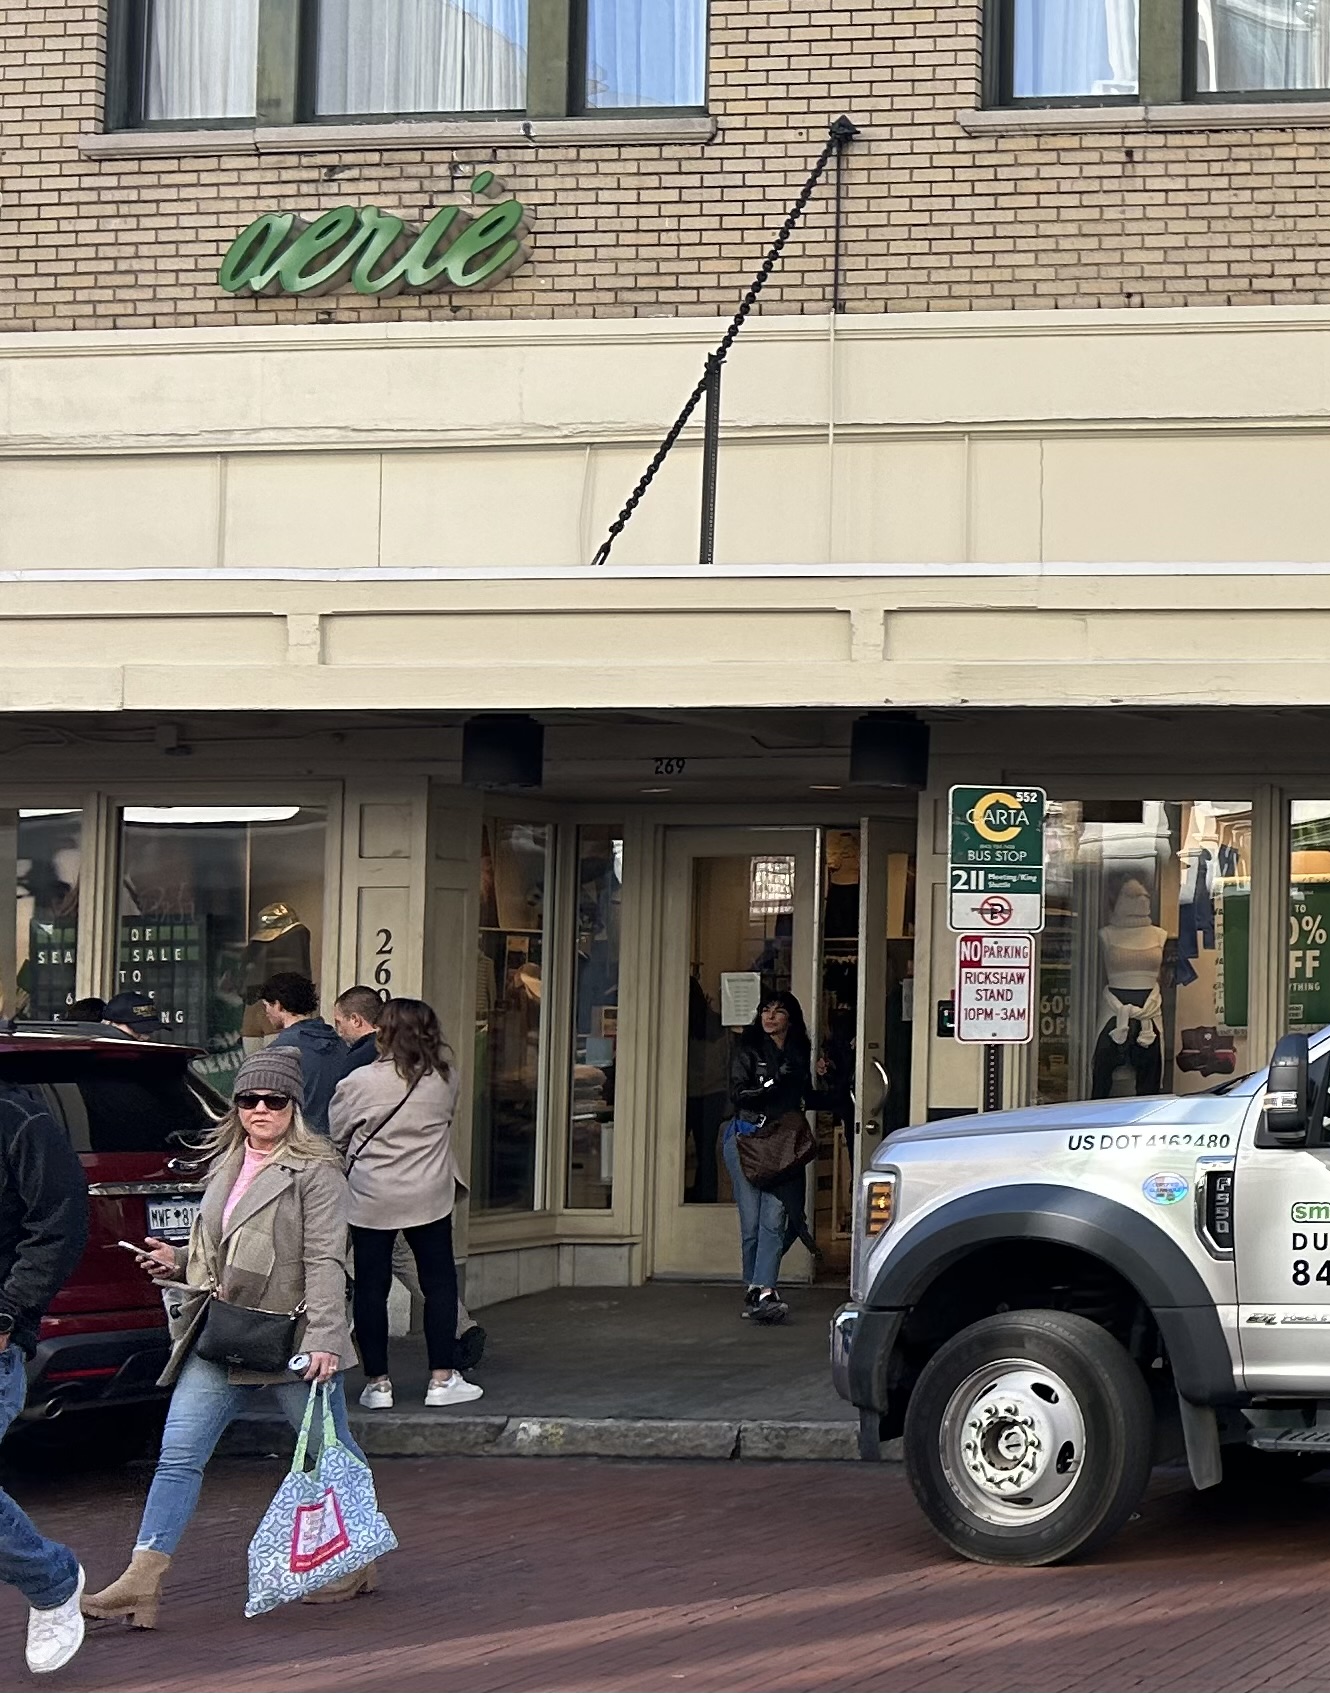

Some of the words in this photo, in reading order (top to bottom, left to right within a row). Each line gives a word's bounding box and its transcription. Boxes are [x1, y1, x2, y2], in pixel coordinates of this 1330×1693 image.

[220, 171, 524, 293] aerie
[655, 757, 686, 774] 269
[1016, 792, 1038, 803] 552
[966, 808, 1030, 826] CARTA
[968, 850, 991, 861] BUS
[995, 850, 1027, 861] STOP
[952, 870, 985, 890] 211
[1295, 904, 1306, 913] TO
[131, 928, 152, 941] OF
[132, 949, 182, 962] SALE
[960, 941, 981, 961] NO
[983, 946, 1029, 959] PARKING
[1289, 950, 1320, 979] FF
[119, 970, 142, 983] TO
[965, 972, 1026, 985] RICKSHAW
[975, 989, 1014, 1002] STAND
[1069, 1134, 1096, 1151] US
[1100, 1134, 1142, 1150] DOT
[183, 1207, 200, 1227] 81
